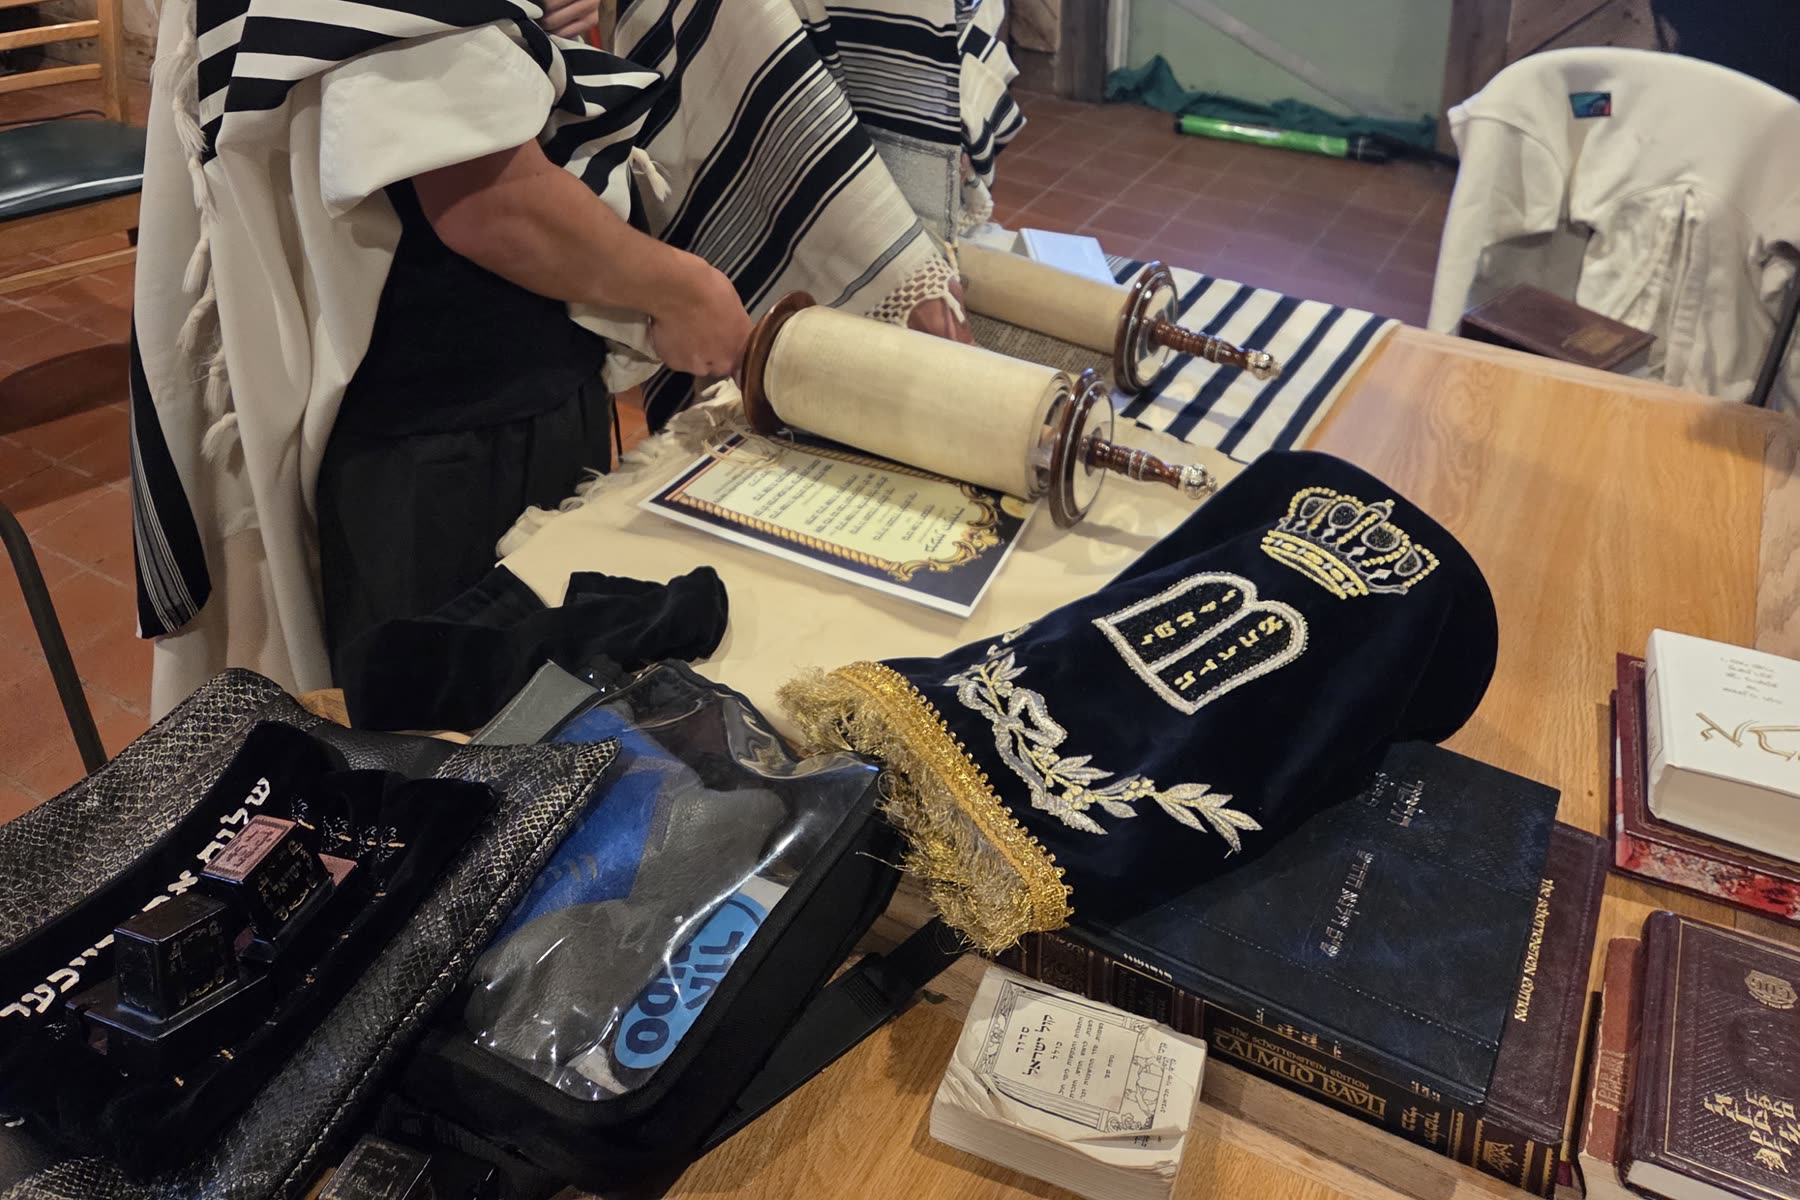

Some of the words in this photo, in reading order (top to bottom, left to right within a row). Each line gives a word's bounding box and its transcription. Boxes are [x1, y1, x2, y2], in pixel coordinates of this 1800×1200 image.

[1033, 1014, 1055, 1033] קול
[1015, 1026, 1030, 1053] סדור
[1049, 1041, 1063, 1060] כולל
[1021, 1036, 1046, 1076] ישראל
[1320, 1077, 1389, 1117] BAVLI
[1744, 1088, 1796, 1120] השלם
